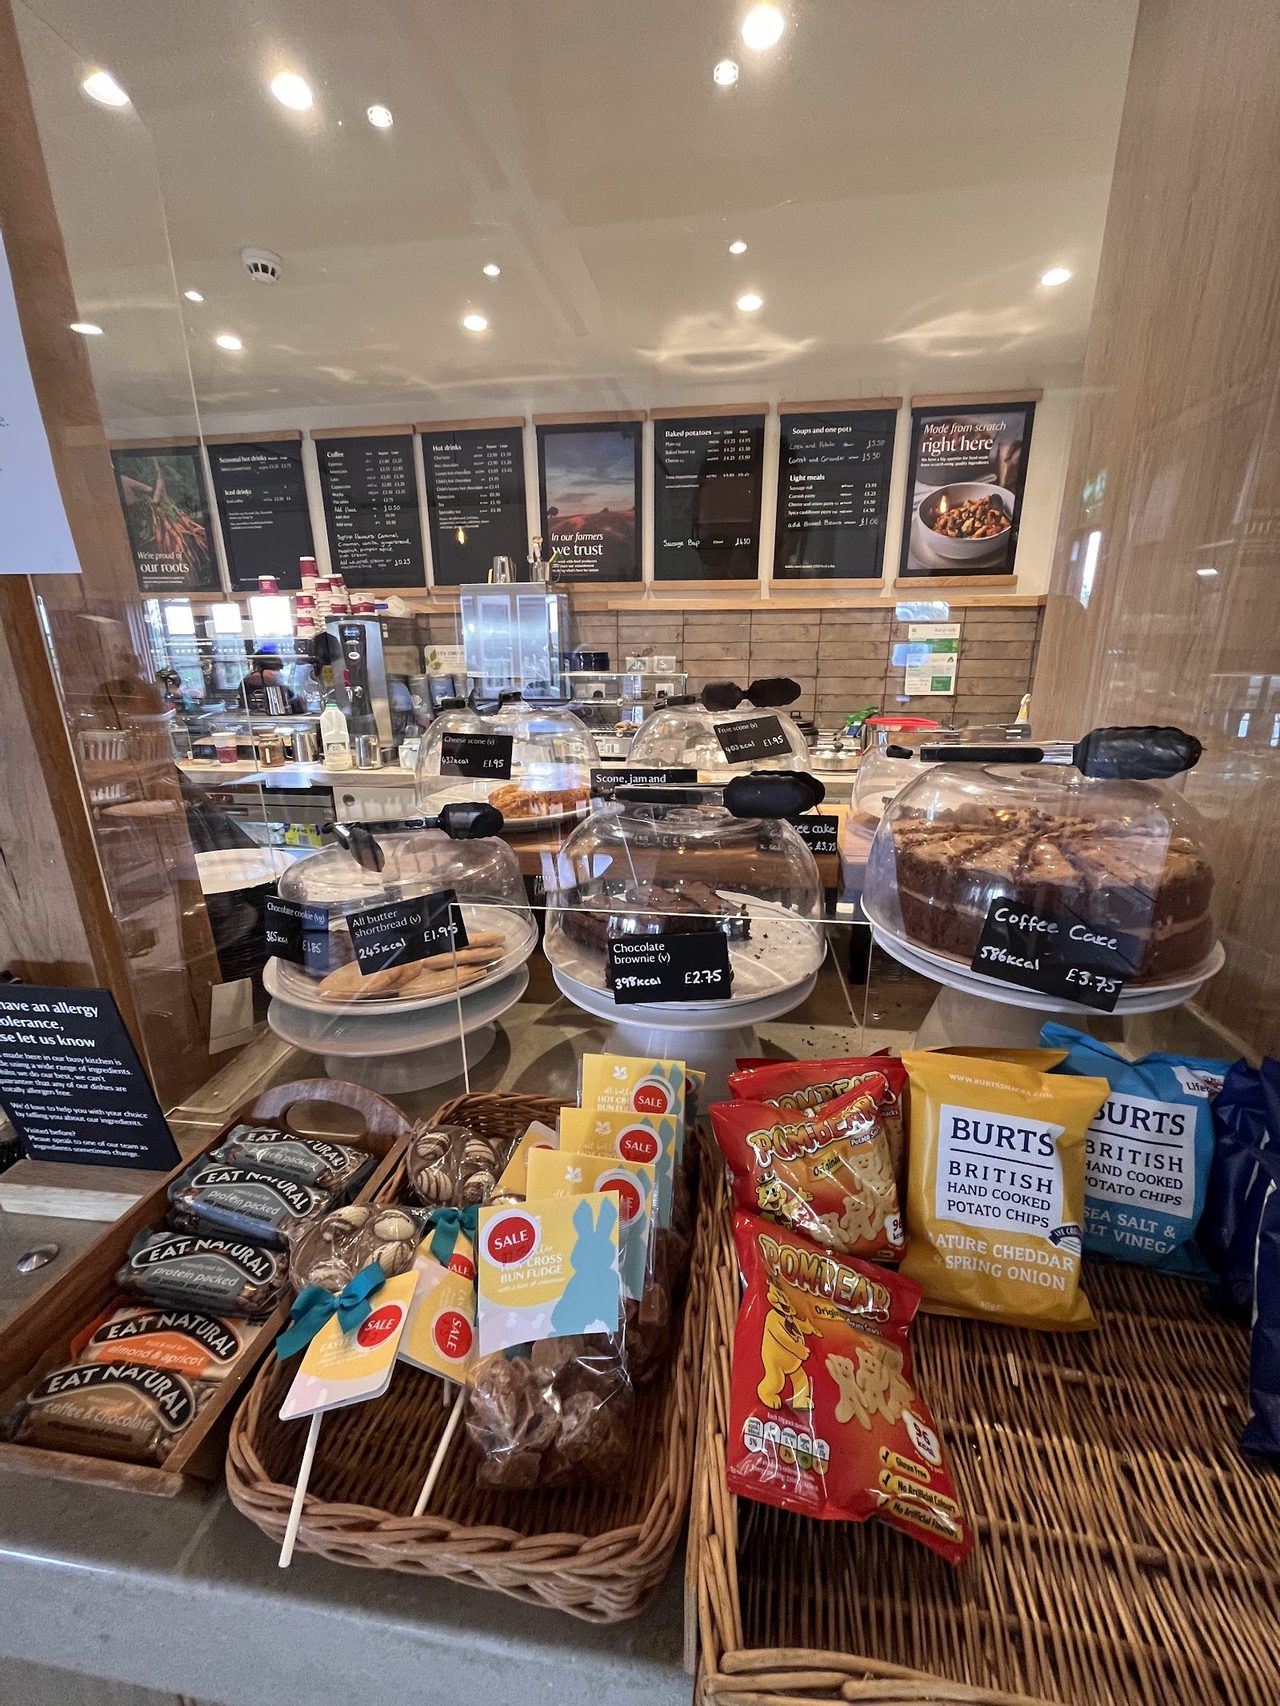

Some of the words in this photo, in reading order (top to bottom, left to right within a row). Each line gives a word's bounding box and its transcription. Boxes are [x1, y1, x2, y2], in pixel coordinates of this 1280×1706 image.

[665, 430, 684, 438] Baked
[792, 427, 811, 436] Soups
[837, 426, 852, 434] pots
[924, 424, 949, 434] Made
[949, 422, 972, 436] from
[975, 420, 1007, 432] scratch
[922, 436, 956, 457] right
[960, 435, 994, 451] here
[790, 475, 806, 483] Light
[551, 532, 559, 541] In
[561, 533, 573, 541] our
[574, 532, 604, 543] farmers
[137, 552, 154, 560] We're
[155, 552, 174, 561] proud
[175, 551, 183, 562] of
[552, 545, 570, 556] we
[574, 544, 603, 556] trust
[141, 563, 159, 573] our
[161, 563, 189, 573] roots
[718, 726, 732, 734] Fruit
[733, 724, 749, 732] scone
[444, 736, 466, 744] Cheese
[763, 735, 784, 747] £1.95
[483, 759, 504, 768] £1.95
[596, 774, 627, 784] Scone,
[628, 774, 647, 785] jam
[648, 774, 666, 783] and
[812, 824, 836, 834] cake
[266, 902, 294, 916] Chocolate
[294, 909, 313, 921] cookie
[313, 912, 325, 924] (vg)
[352, 916, 365, 928] All
[366, 910, 398, 926] butter
[354, 918, 408, 939] shortbread
[409, 914, 422, 925] (v)
[423, 922, 459, 943] £1.95
[994, 907, 1059, 934] Coffee
[1069, 924, 1117, 950] Cake
[359, 938, 407, 960] 245kcal
[613, 942, 665, 953] Chocolate
[614, 953, 656, 964] brownie
[658, 952, 671, 964] (v)
[980, 945, 1040, 971] 586kcal
[615, 976, 662, 990] 398kcal
[684, 969, 722, 984] £2.75
[1065, 968, 1123, 993] £3.75
[32, 1003, 51, 1013] an
[52, 1002, 98, 1018] allergy
[16, 1032, 38, 1044] let
[38, 1036, 56, 1046] us
[57, 1034, 96, 1048] know
[65, 1055, 84, 1064] busy
[84, 1056, 114, 1066] kitchen
[114, 1058, 122, 1066] is
[88, 1065, 133, 1076] ingredients.
[90, 1083, 115, 1092] dishes
[638, 1095, 663, 1108] SALE
[56, 1106, 73, 1114] help
[88, 1108, 106, 1116] with
[124, 1111, 148, 1119] choice
[28, 1134, 51, 1142] Please
[951, 1116, 1054, 1157] BURTS
[624, 1140, 652, 1154] SALE
[1085, 1140, 1184, 1174] BRITISH
[206, 1170, 245, 1184] EAT
[949, 1160, 1053, 1194] BRITISH
[1127, 1170, 1184, 1191] COOKED
[947, 1181, 988, 1197] HAND
[992, 1189, 1051, 1211] COOKED
[1086, 1175, 1135, 1197] OTATO
[1139, 1188, 1182, 1206] CHIPS
[207, 1189, 242, 1206] protein
[242, 1198, 282, 1216] packed
[947, 1199, 1001, 1218] POTATO
[1006, 1208, 1049, 1228] CHIPS
[1084, 1207, 1111, 1223] SEA
[1117, 1213, 1159, 1234] SALT
[1166, 1224, 1176, 1240] &
[494, 1229, 529, 1250] SALE
[149, 1240, 192, 1262] EAT
[194, 1239, 270, 1277] NATURAL
[526, 1253, 563, 1268] CROSS
[993, 1243, 1074, 1273] CHEDDAR
[152, 1266, 198, 1280] protein
[194, 1273, 240, 1287] packed
[500, 1270, 525, 1284] BUN
[526, 1265, 563, 1279] FUDGE
[946, 1254, 1001, 1278] SPRING
[1007, 1266, 1066, 1292] ONION
[364, 1317, 396, 1332] SALE
[107, 1316, 154, 1340] EAT
[157, 1312, 236, 1356] NATURAL
[446, 1317, 462, 1352] SALE
[107, 1345, 150, 1359] almond
[152, 1351, 159, 1361] &
[160, 1352, 205, 1367] apricot
[46, 1367, 101, 1394] EAT
[102, 1364, 188, 1420] NATURAL
[43, 1401, 82, 1419] coffee
[83, 1409, 92, 1420] &
[92, 1410, 156, 1432] chocolate
[913, 1422, 931, 1446] 96
[897, 1480, 907, 1493] No
[908, 1484, 933, 1502] Artificial
[893, 1502, 904, 1513] No
[904, 1506, 932, 1525] Artificial
